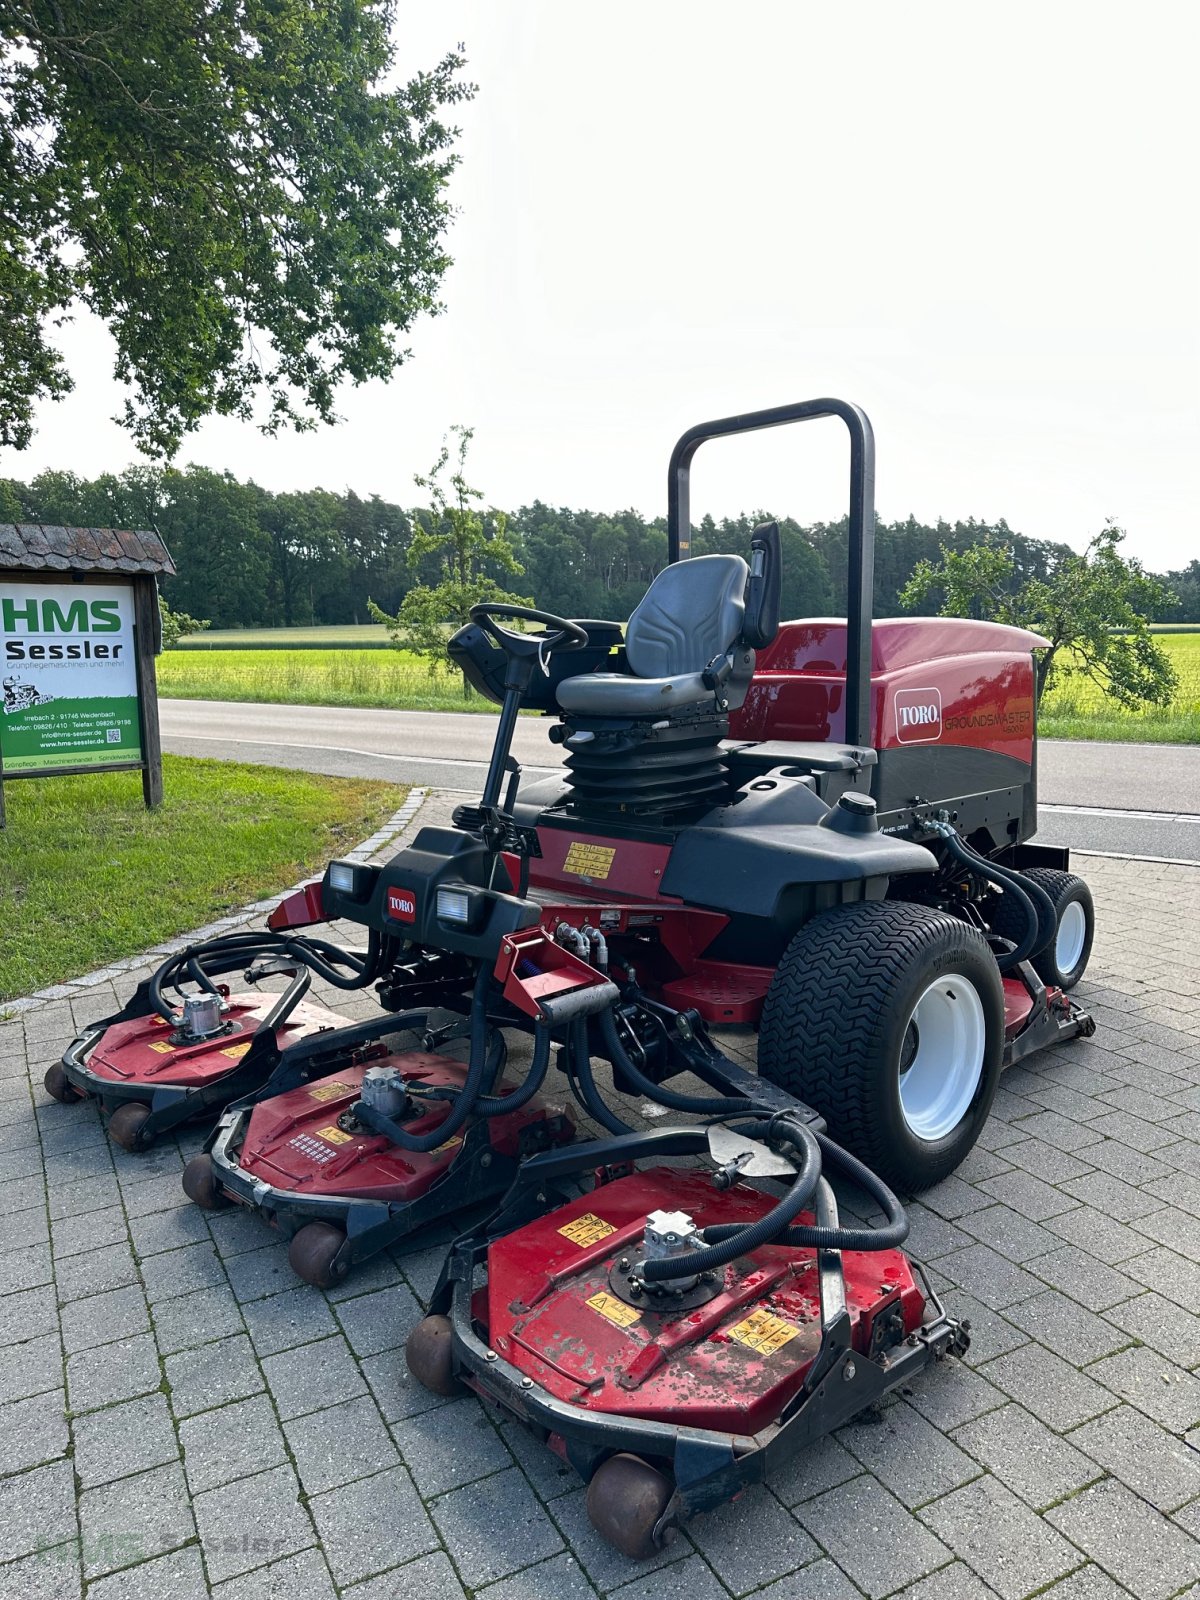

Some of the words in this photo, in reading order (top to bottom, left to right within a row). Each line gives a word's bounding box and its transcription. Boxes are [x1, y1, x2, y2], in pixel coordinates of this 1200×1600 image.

[2, 598, 121, 632] HMS
[5, 641, 123, 660] Sessler
[89, 660, 104, 668] und
[80, 711, 115, 719] Weidenbach
[900, 704, 938, 726] TORO
[944, 711, 1030, 730] GROUNDSMASTER
[40, 739, 105, 748] www.hms-sessler.de
[389, 896, 414, 914] TORO
